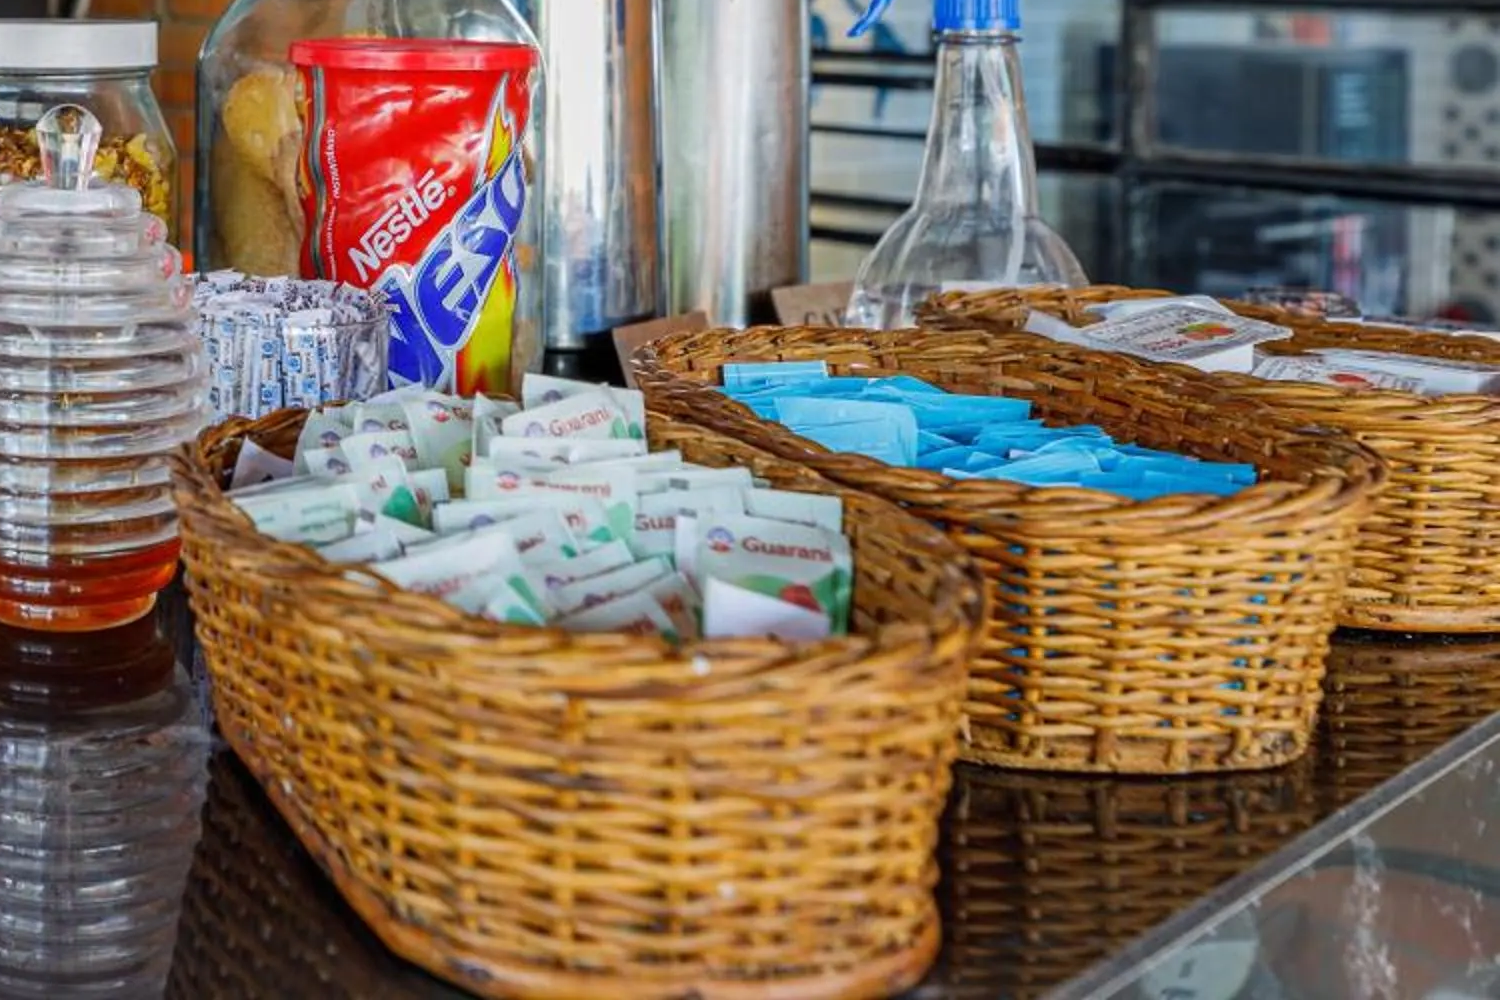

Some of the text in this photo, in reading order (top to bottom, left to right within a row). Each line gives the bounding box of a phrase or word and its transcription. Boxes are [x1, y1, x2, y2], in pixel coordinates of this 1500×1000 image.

[347, 167, 447, 283] Nestlé
[549, 406, 612, 437] Guarani
[741, 536, 834, 563] Guarani
